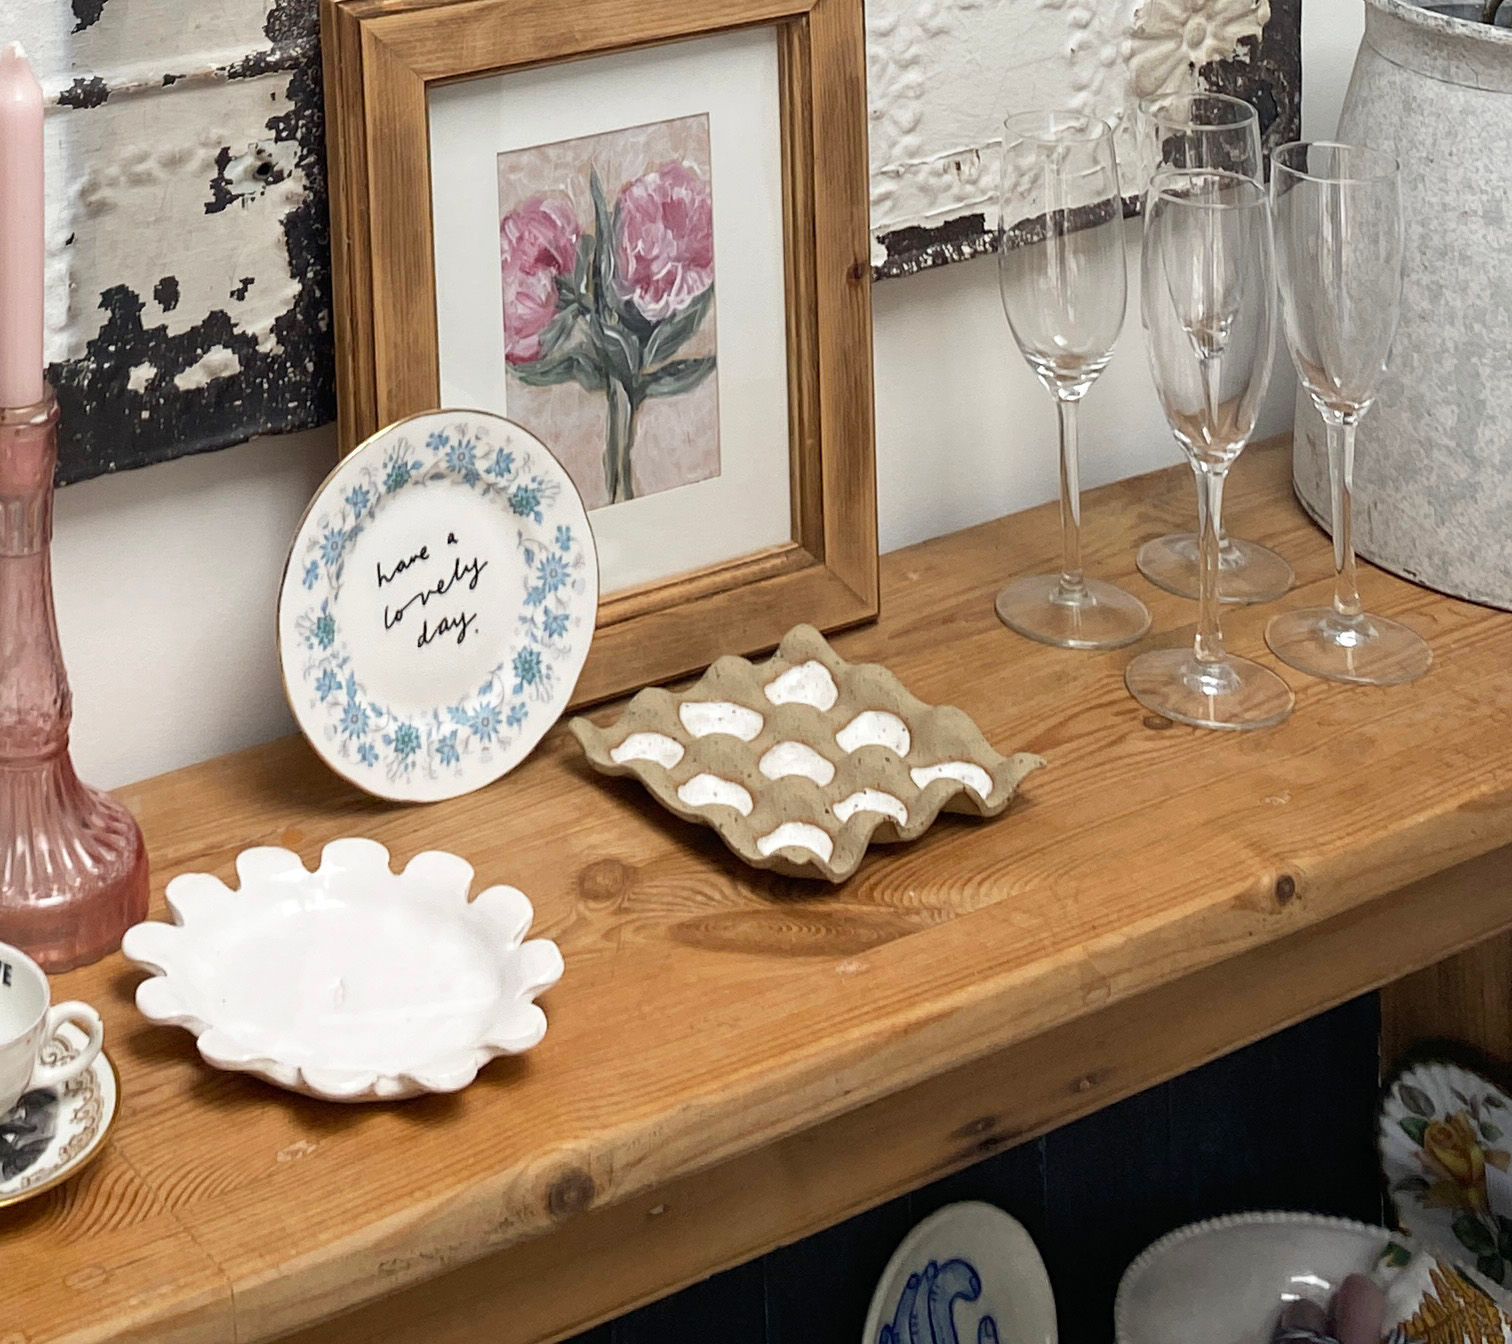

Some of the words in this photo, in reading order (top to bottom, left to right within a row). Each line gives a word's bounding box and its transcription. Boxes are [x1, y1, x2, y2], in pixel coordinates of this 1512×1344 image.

[377, 546, 430, 588] have
[447, 532, 458, 544] a
[384, 557, 488, 630] lovely
[417, 612, 478, 648] day.
